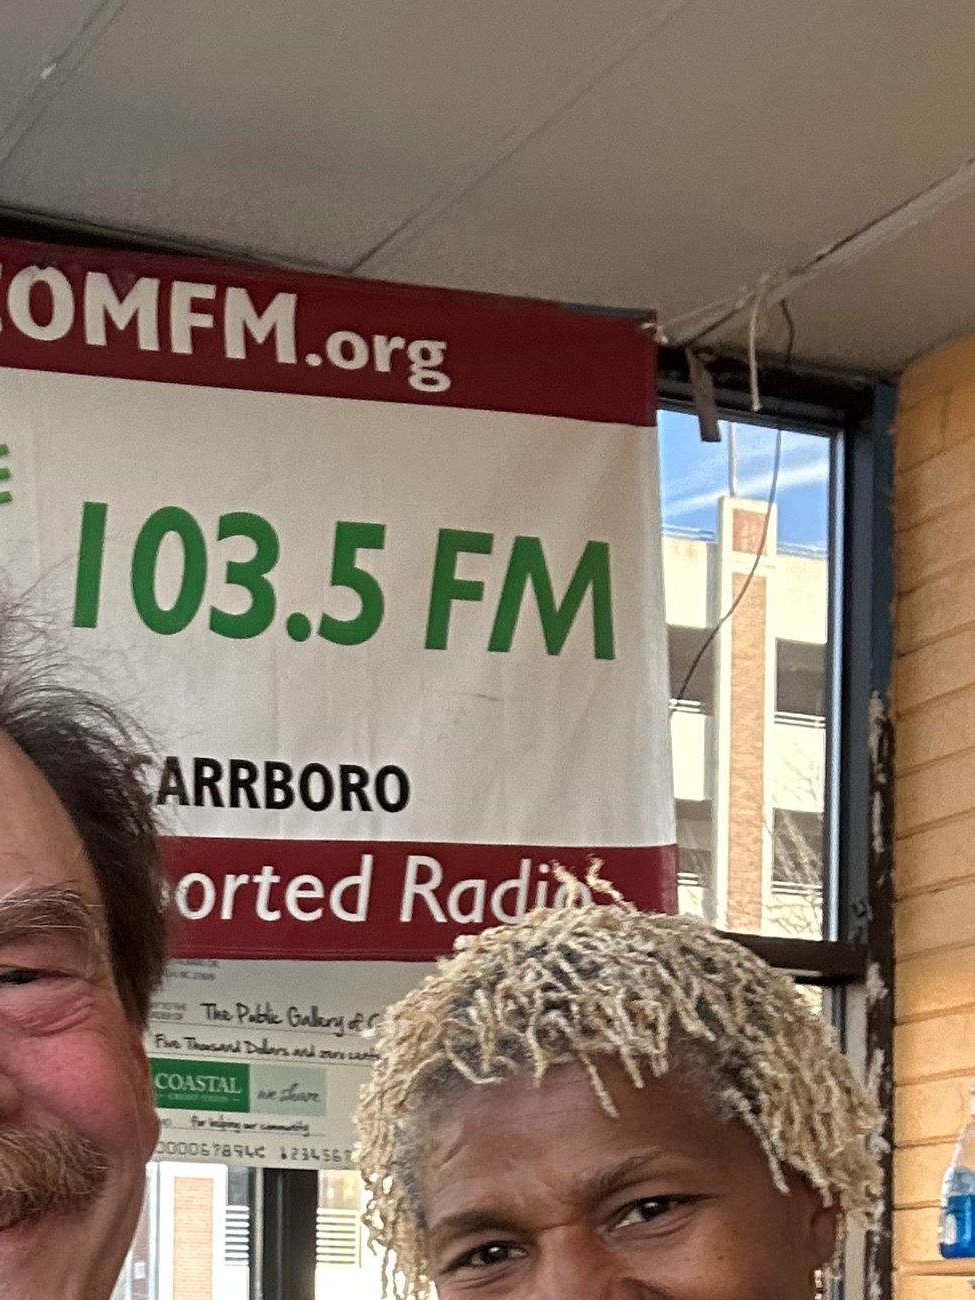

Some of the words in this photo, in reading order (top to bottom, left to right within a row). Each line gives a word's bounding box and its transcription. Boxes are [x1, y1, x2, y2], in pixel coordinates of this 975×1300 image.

[72, 500, 387, 646] 103.5
[424, 527, 616, 661] FM
[163, 853, 374, 923] orted
[199, 1003, 233, 1021] The
[154, 1072, 241, 1094] COASTAL
